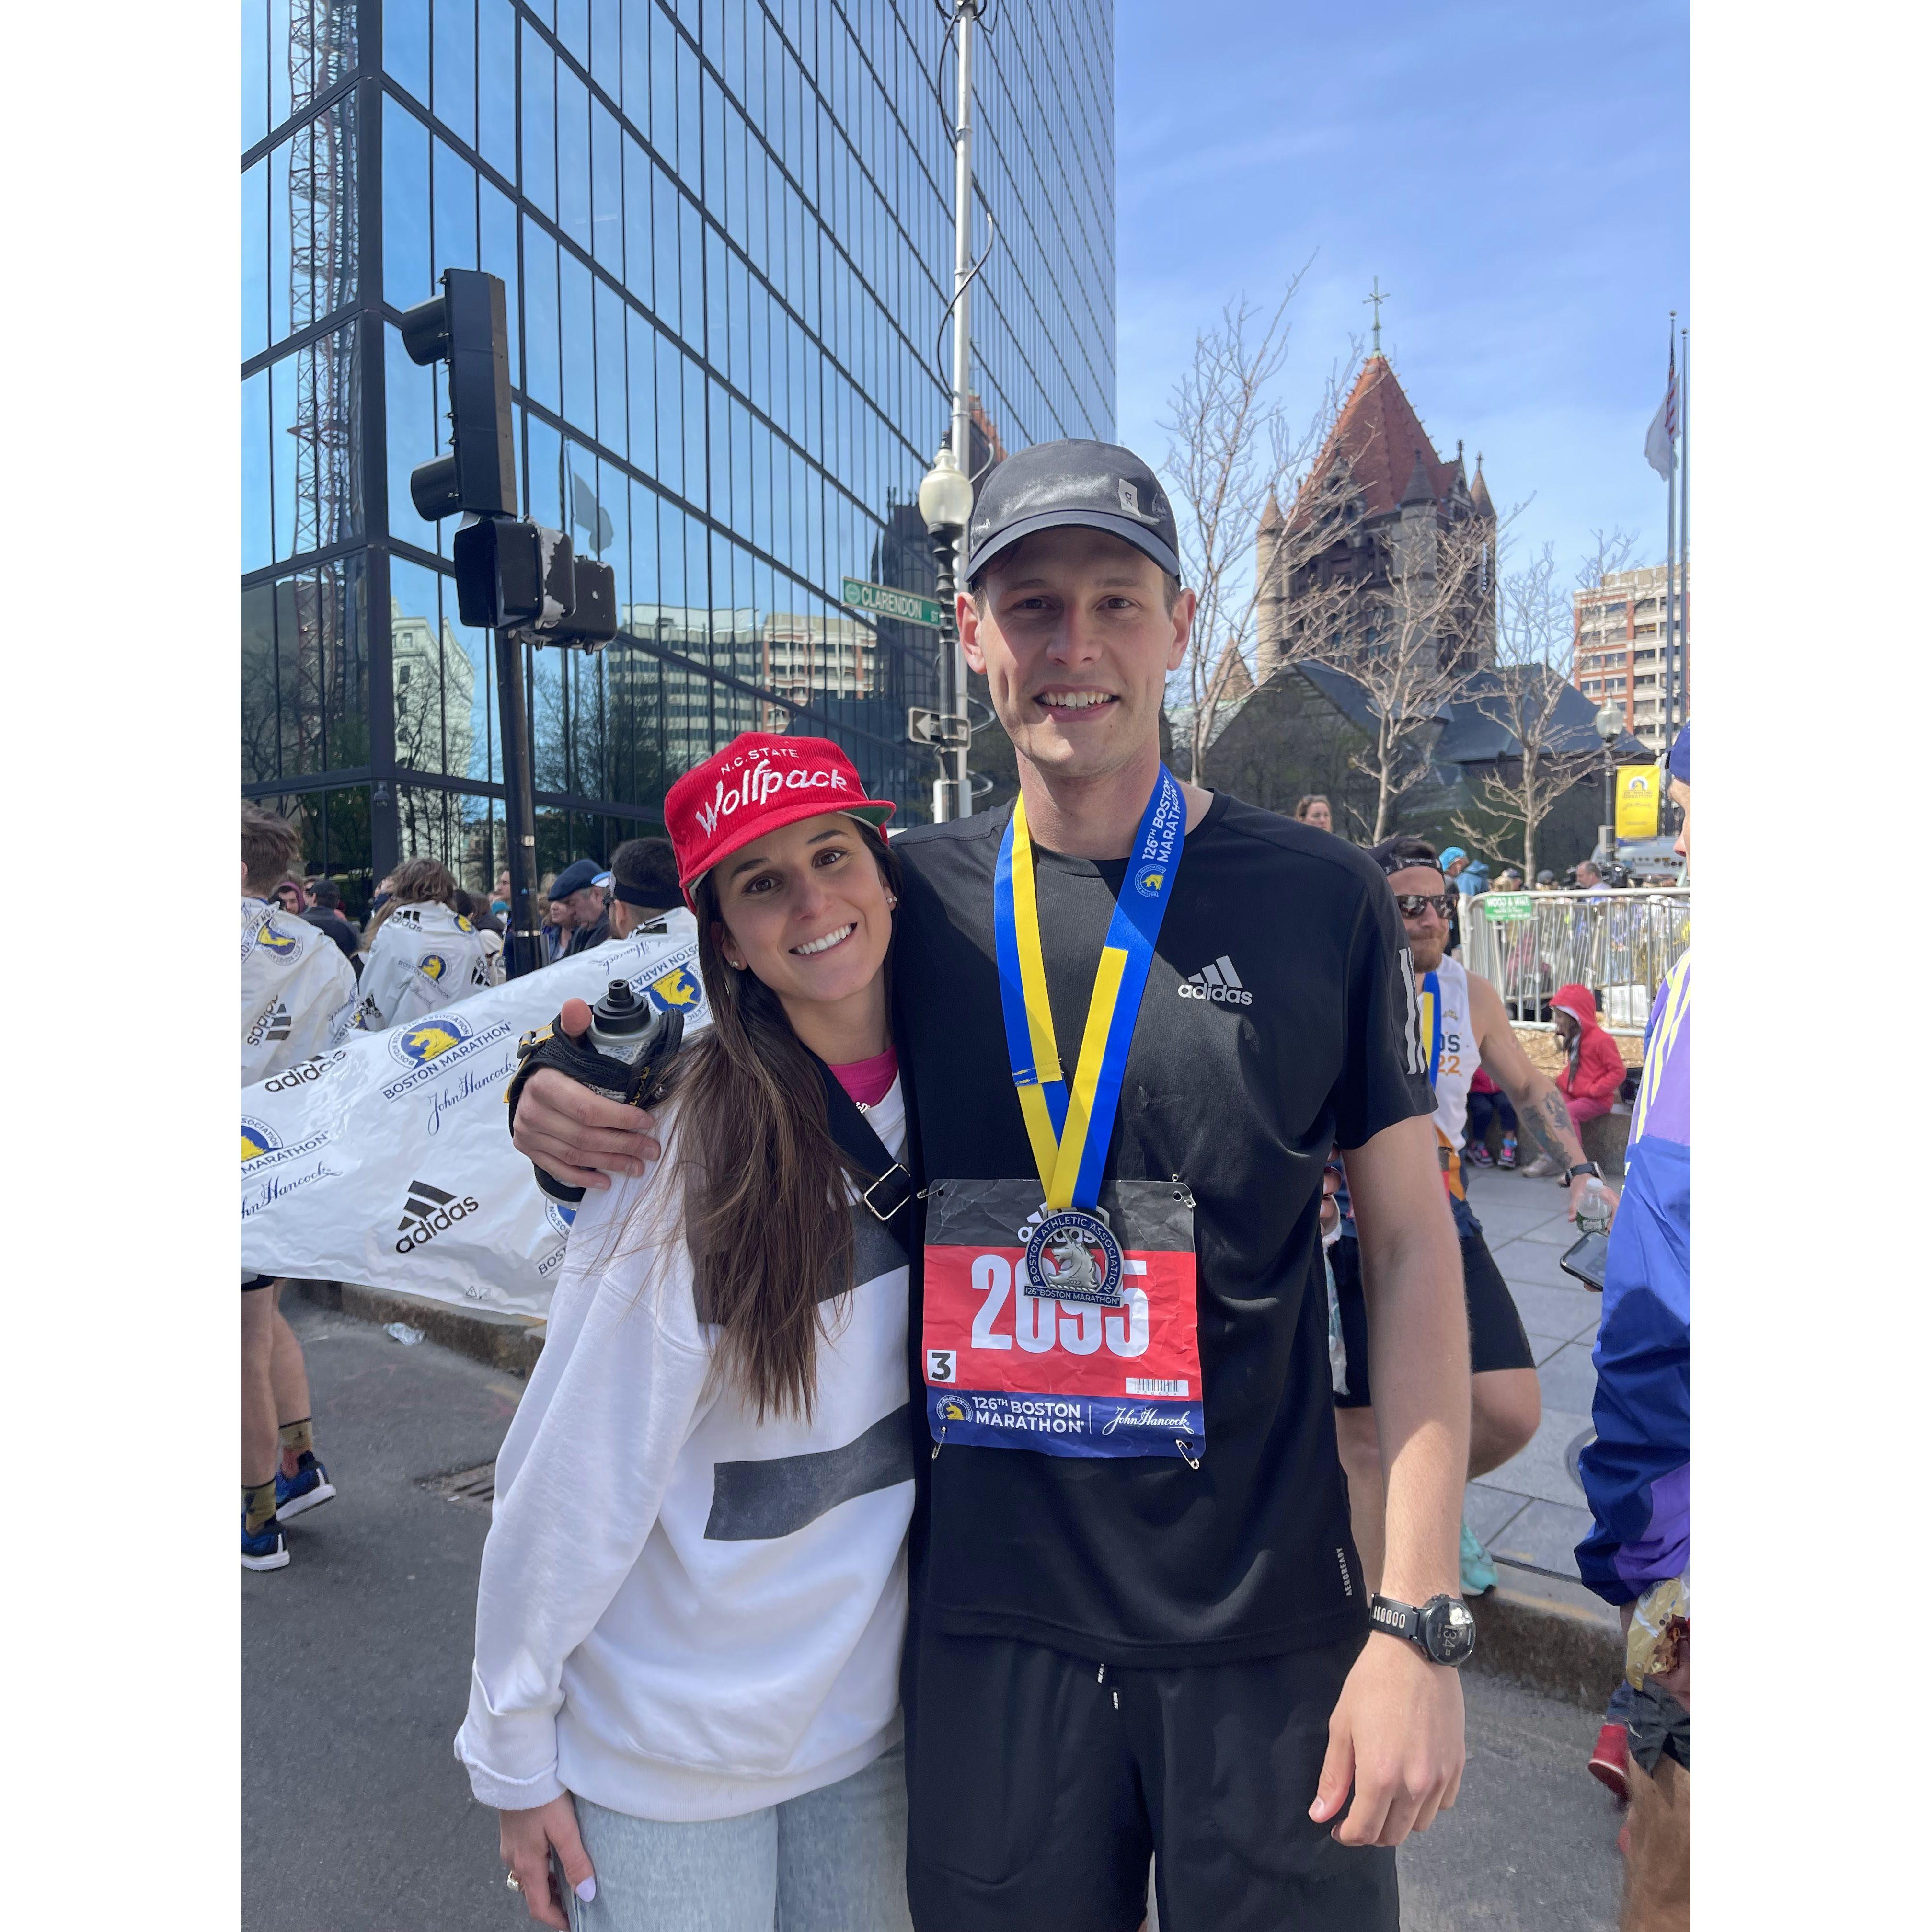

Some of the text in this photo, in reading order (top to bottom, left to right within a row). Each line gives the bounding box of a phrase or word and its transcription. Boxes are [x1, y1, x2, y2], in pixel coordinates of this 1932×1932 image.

[862, 586, 939, 622] CLARENDON ST
[695, 759, 847, 838] Wolfpack
[1152, 775, 1172, 829] BOSTON
[1156, 785, 1181, 862] MARATHON
[1178, 983, 1253, 1005] adidas
[265, 1051, 346, 1092] adidas
[383, 1023, 511, 1099] BOSTON MARATHON
[391, 1044, 415, 1066] BOSTON
[427, 1052, 516, 1136] John Hancock
[242, 1132, 328, 1174] MARATHON
[260, 1161, 343, 1207] Hancock
[396, 1197, 479, 1254] adidas
[1029, 1216, 1118, 1293] BOSTON ATHLETIC ASSOCIATION
[971, 1254, 1149, 1357] 2095
[1040, 1288, 1071, 1299] BOSTON
[1073, 1294, 1118, 1305] MARATHON
[932, 1352, 951, 1380] 3
[972, 1397, 1080, 1418] 126TH BOSTON
[976, 1411, 1082, 1434] MARATHON
[1102, 1406, 1195, 1436] John Hancock
[1336, 1548, 1352, 1596] AEROREADY
